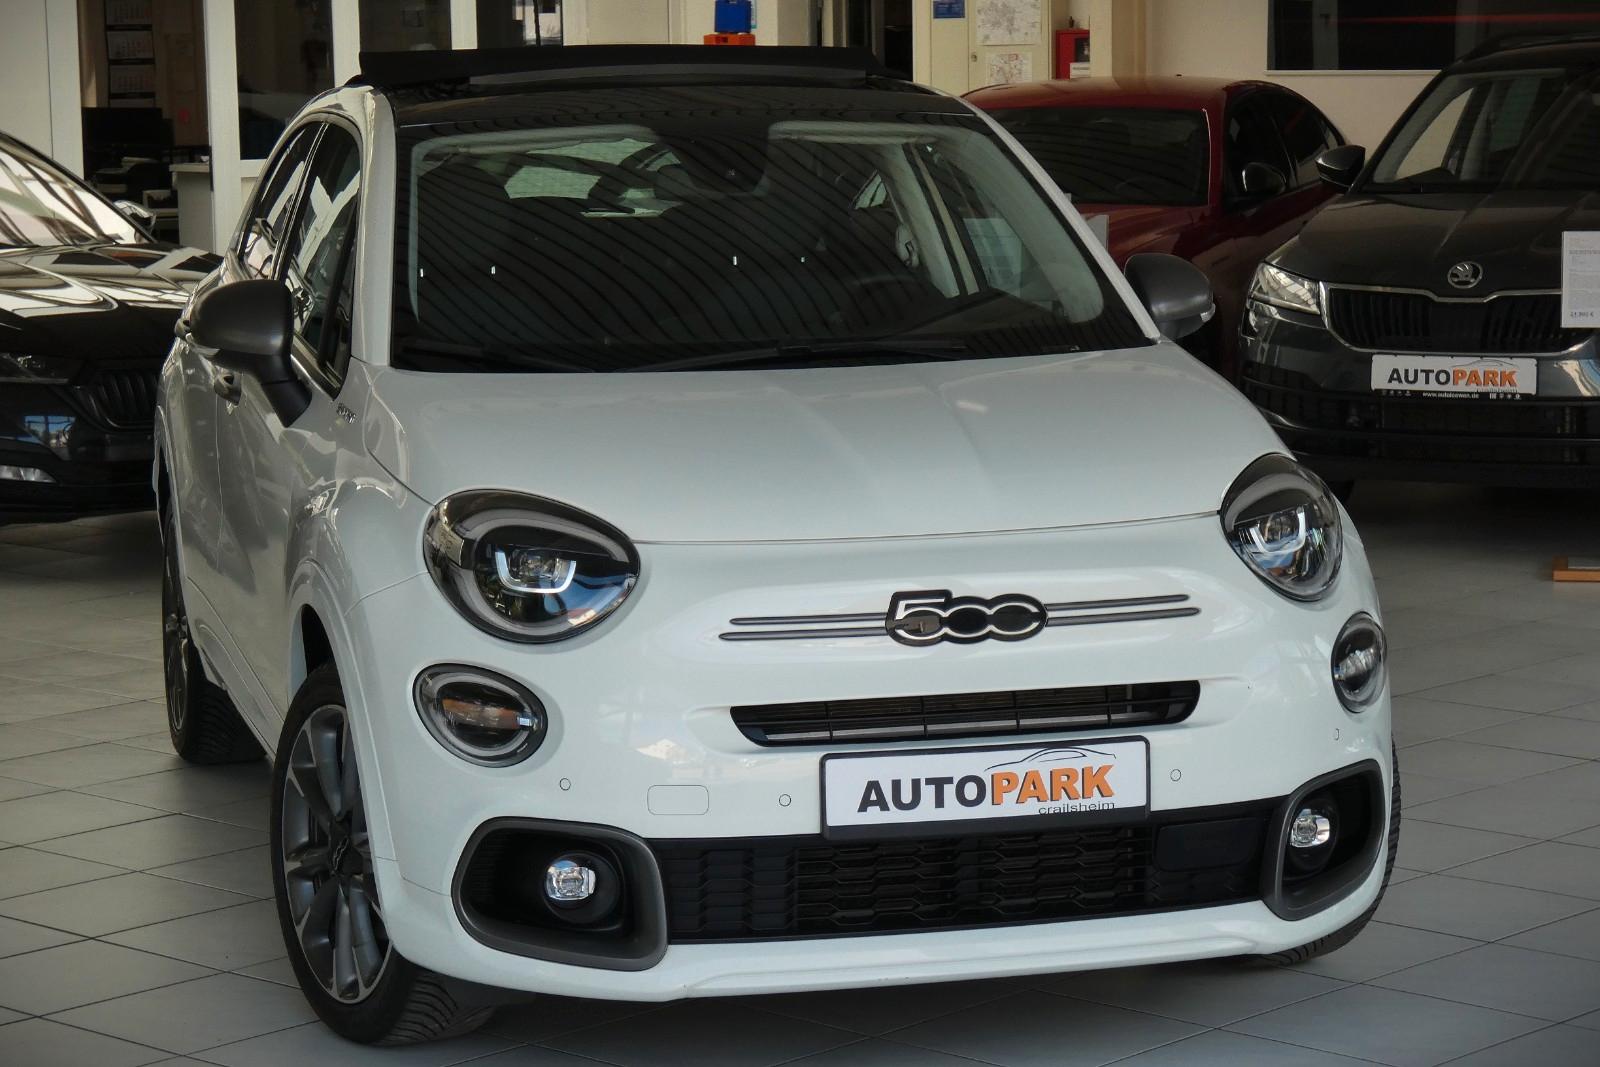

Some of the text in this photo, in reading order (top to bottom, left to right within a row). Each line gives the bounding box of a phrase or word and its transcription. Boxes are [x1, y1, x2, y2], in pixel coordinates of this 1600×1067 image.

[1388, 368, 1518, 387] AUTOPARK
[887, 589, 1047, 647] 500
[857, 764, 1114, 813] AUTOPARK
[1038, 802, 1115, 815] crailsheim
